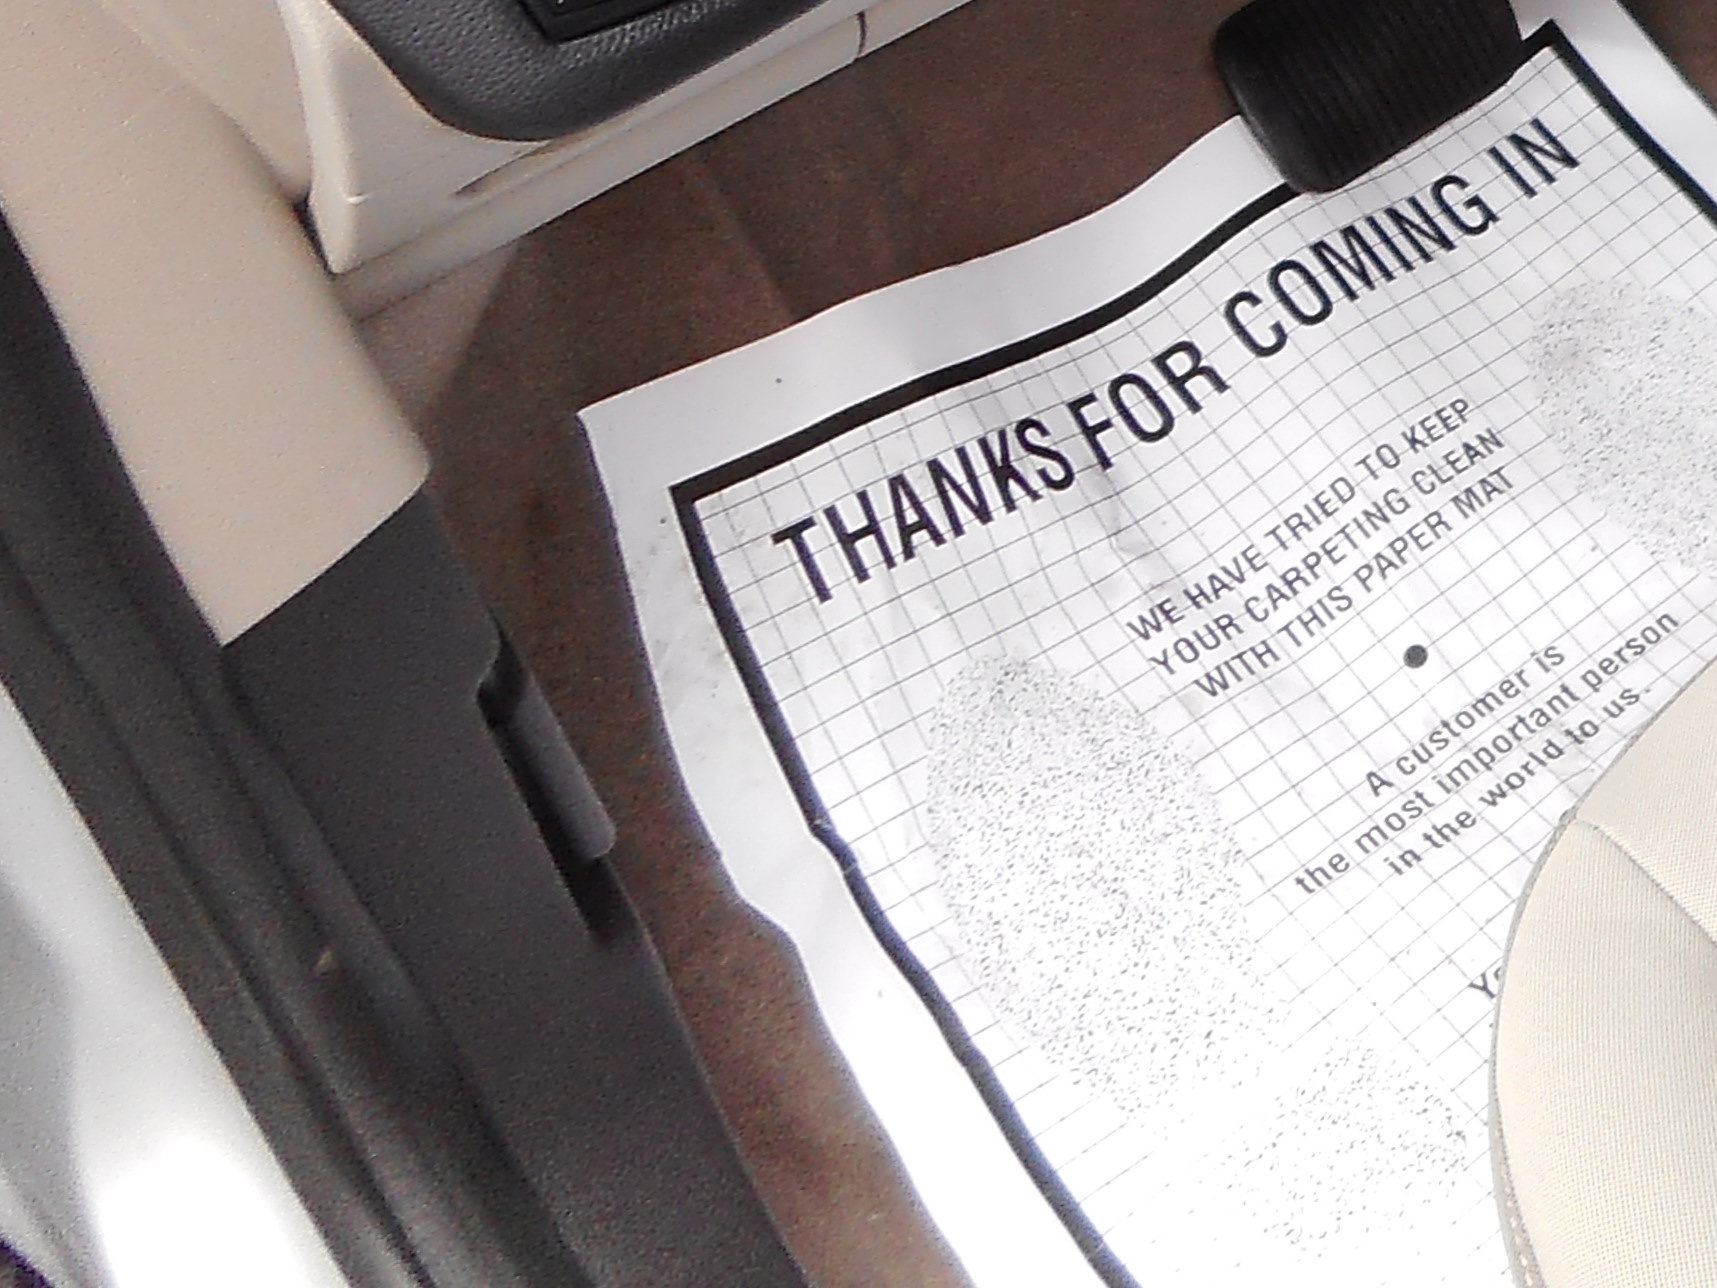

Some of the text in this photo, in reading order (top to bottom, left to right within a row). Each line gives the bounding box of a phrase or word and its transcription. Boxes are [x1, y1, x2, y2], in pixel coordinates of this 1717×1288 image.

[772, 118, 1581, 604] THANKS FOR COMING IN
[1127, 399, 1470, 642] WE HAVE TRIED TO KEEP
[1150, 429, 1505, 678] YOUR CARPETING CLEAN
[1194, 466, 1515, 700] WITH THIS PAPER MAT
[1295, 611, 1679, 894] the most important person
[1365, 644, 1566, 797] A customer is
[1385, 686, 1653, 875] in the world to us.
